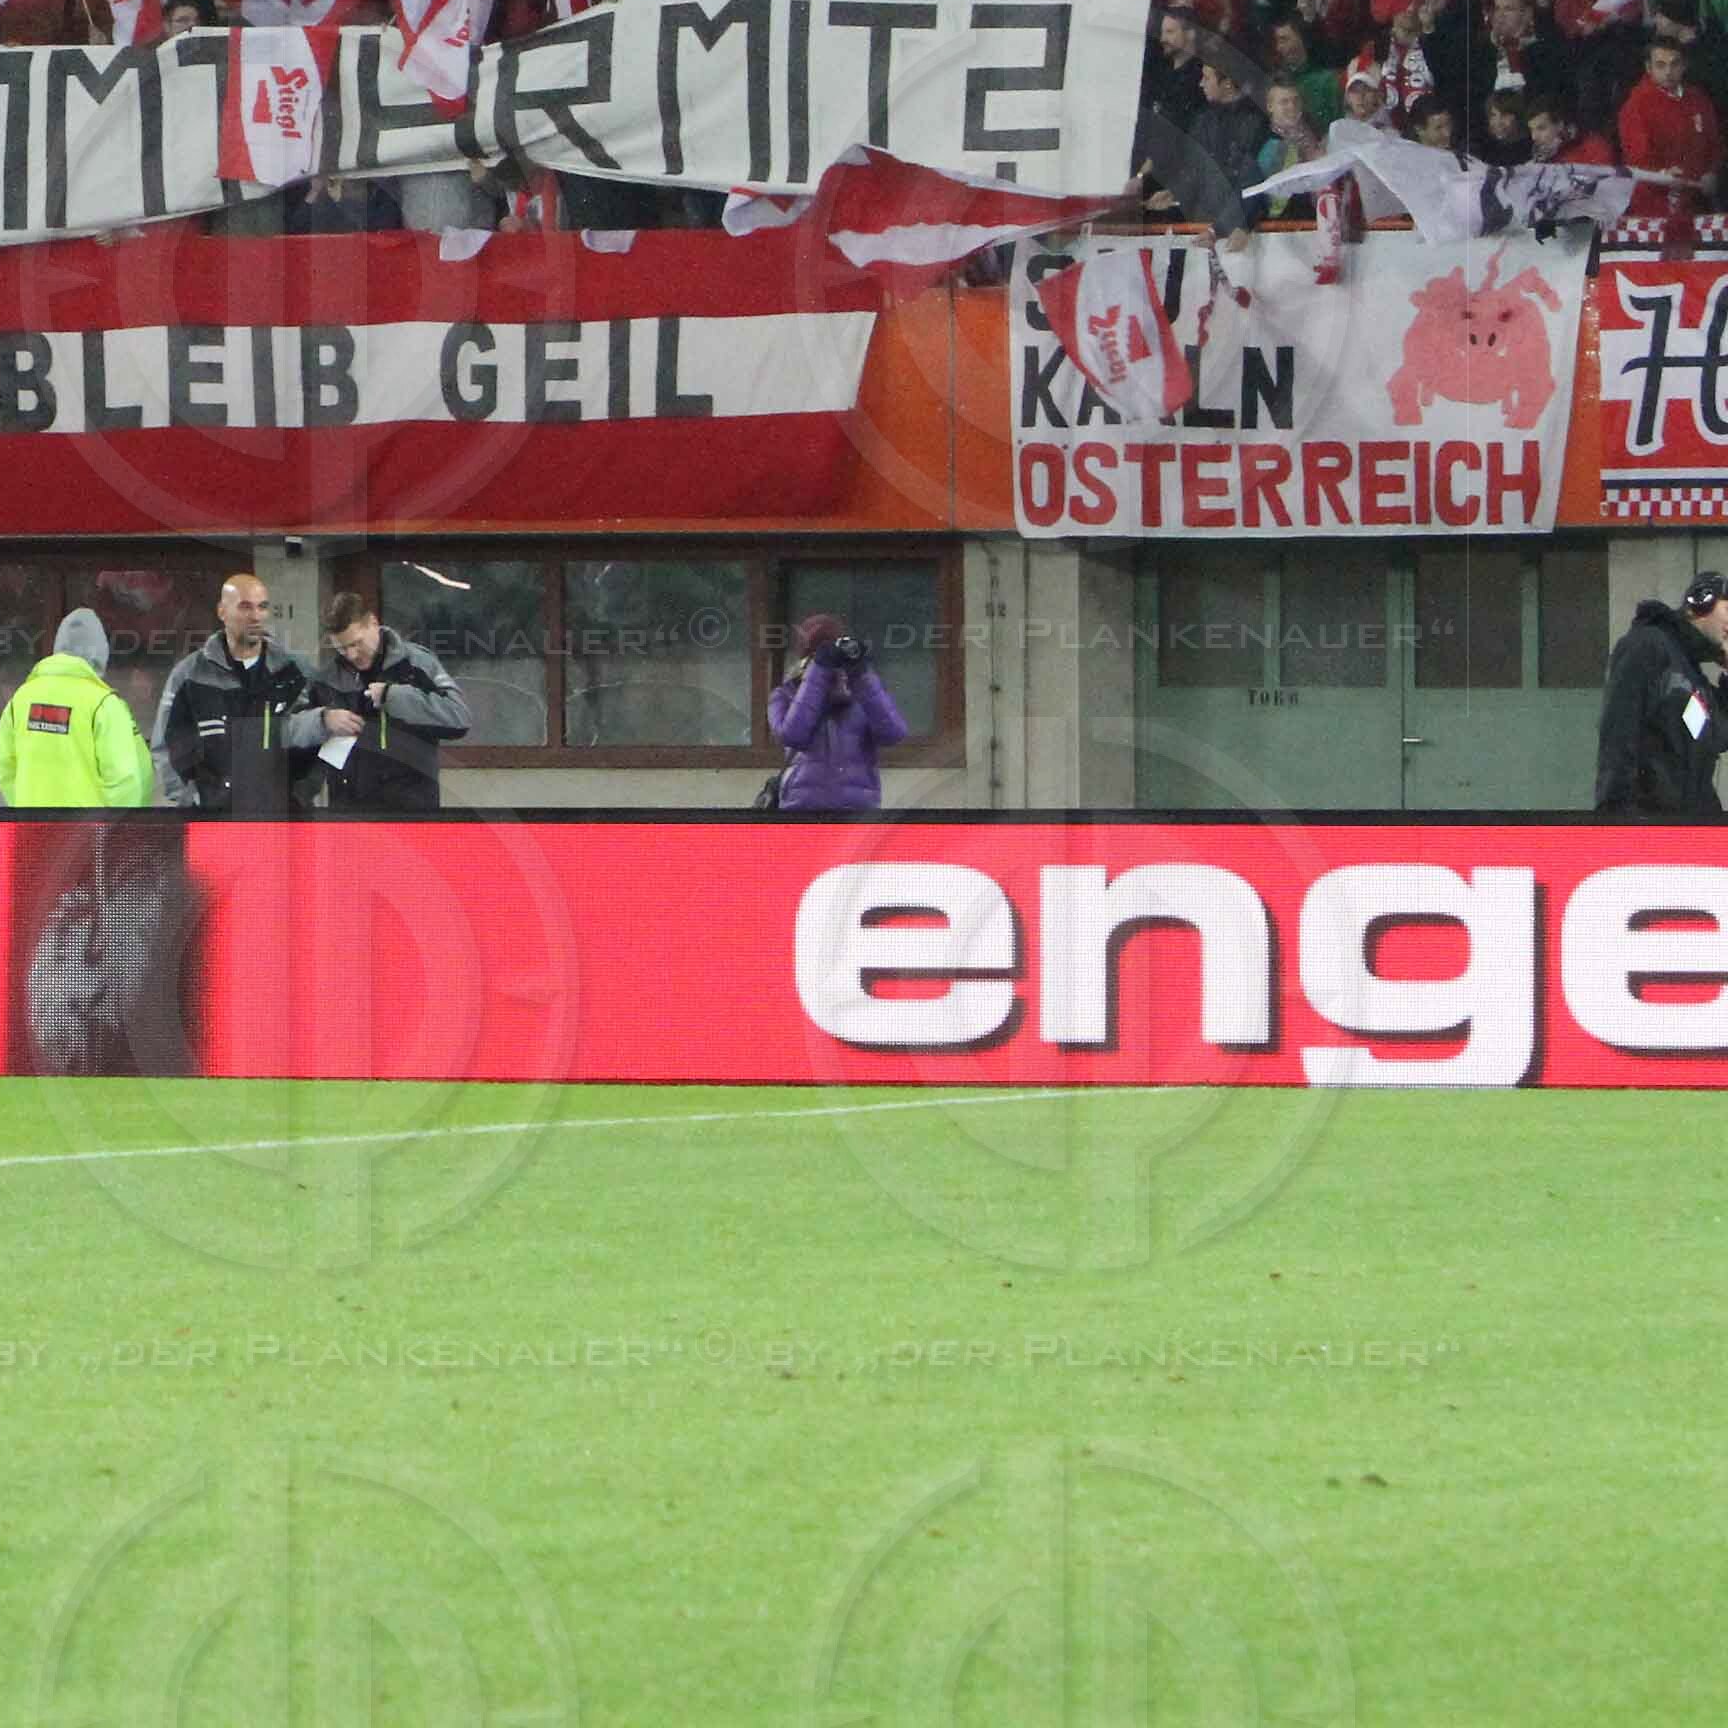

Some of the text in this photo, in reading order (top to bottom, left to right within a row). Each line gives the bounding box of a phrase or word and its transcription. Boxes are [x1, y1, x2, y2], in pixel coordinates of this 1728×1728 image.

[270, 66, 310, 139] Stiegl
[439, 315, 715, 423] GEIL
[1017, 437, 1542, 529] ÖSTERREICH
[795, 860, 1728, 1087] enge
